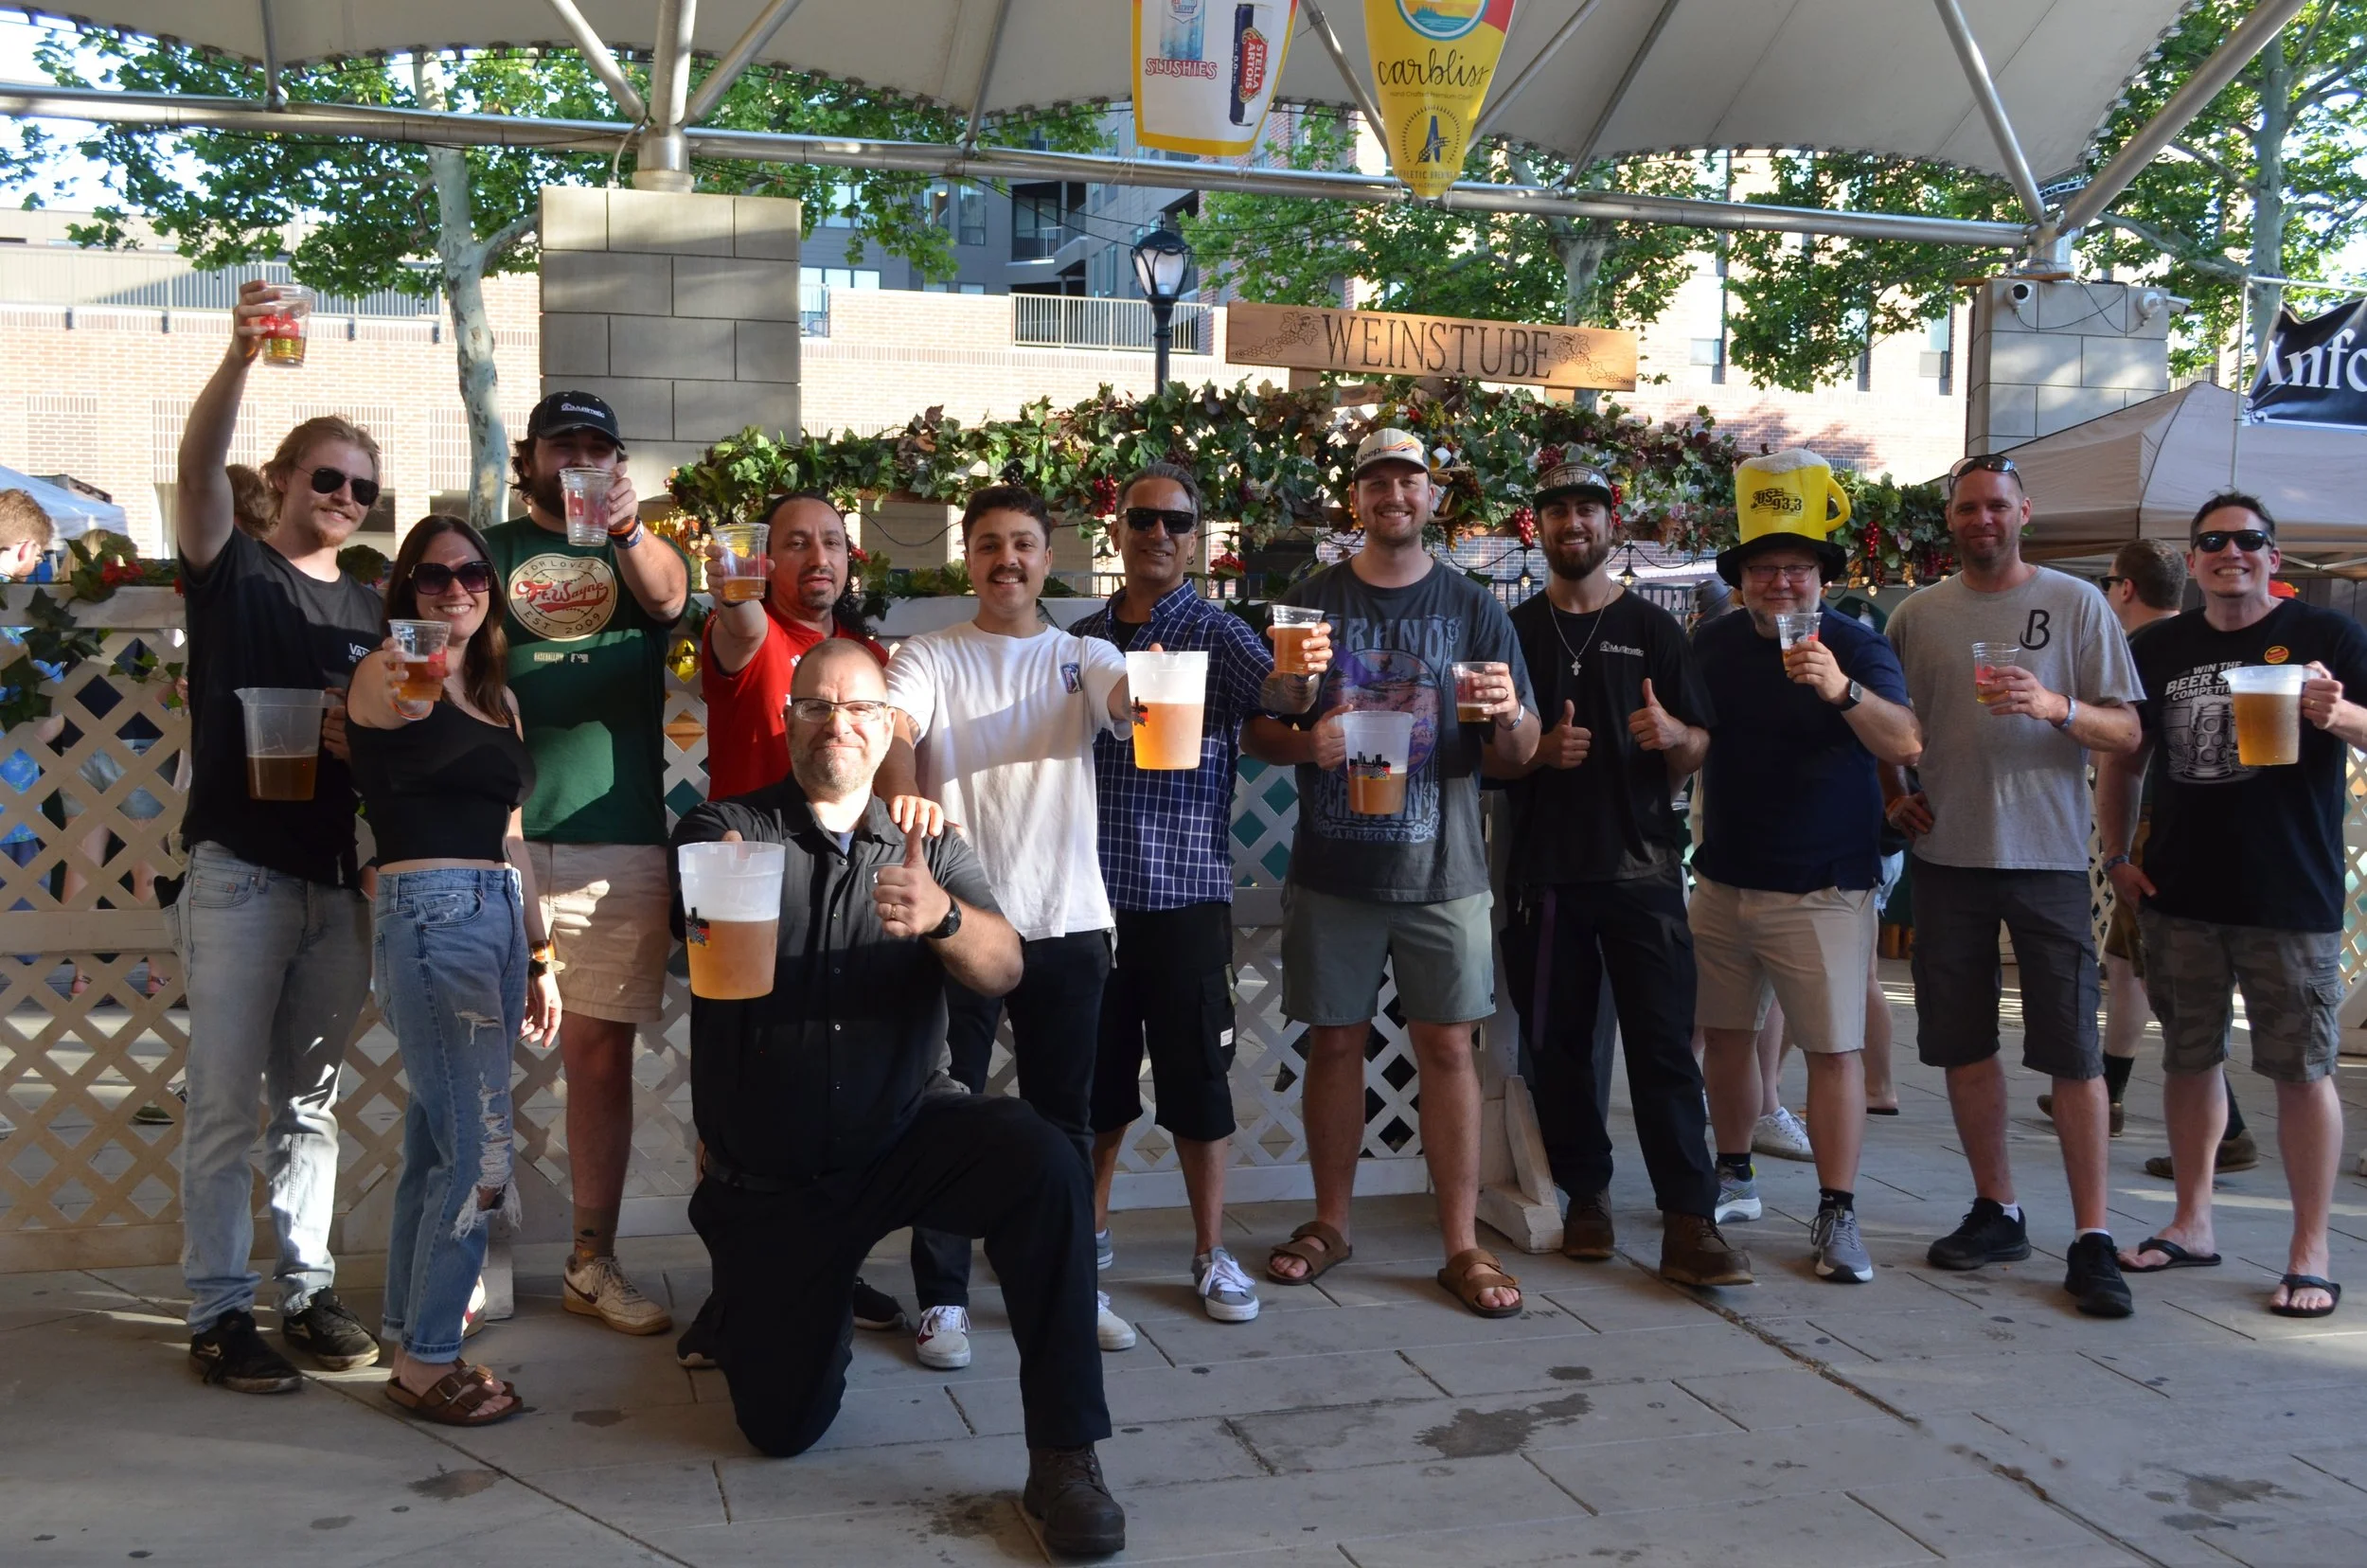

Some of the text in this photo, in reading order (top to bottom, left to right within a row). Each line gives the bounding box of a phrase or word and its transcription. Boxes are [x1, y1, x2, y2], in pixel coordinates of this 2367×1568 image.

[1146, 58, 1218, 80] SLUSHIES
[1245, 42, 1256, 90] ARTOIS
[1254, 44, 1264, 90] STELLA
[1322, 313, 1551, 380] WEINSTUBE
[1358, 448, 1381, 464] Jeep
[524, 561, 545, 576] FOR
[550, 560, 584, 568] LOVE
[552, 579, 605, 603] Wayne
[524, 610, 600, 634] EST. 2009
[2020, 609, 2050, 650] B
[2193, 661, 2243, 675] WIN THE
[2164, 673, 2213, 696] BEER
[2172, 685, 2232, 702] COMPETIT
[1332, 828, 1409, 843] ARIZONA
